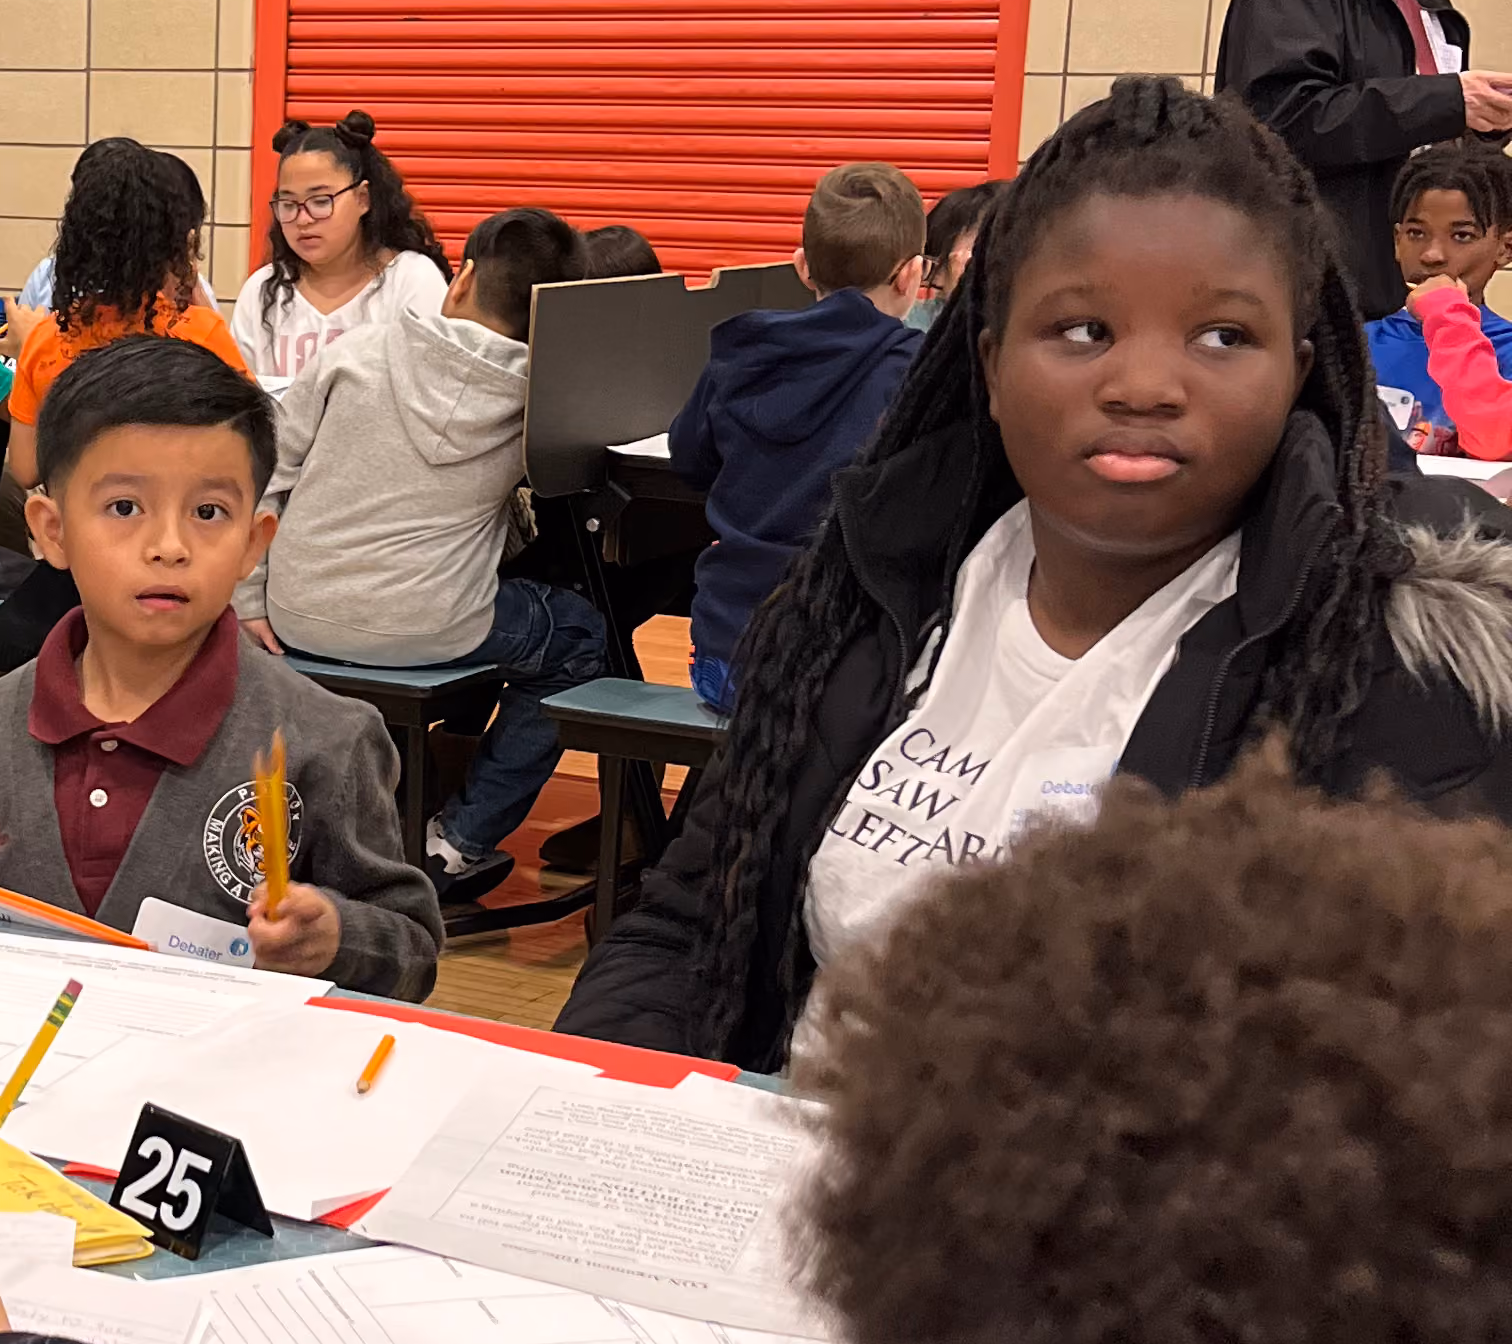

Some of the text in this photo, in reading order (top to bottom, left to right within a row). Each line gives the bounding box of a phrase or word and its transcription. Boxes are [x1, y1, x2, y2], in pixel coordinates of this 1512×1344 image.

[857, 759, 961, 822] SAW
[1040, 780, 1100, 796] Debate
[206, 817, 243, 898] MAKING A
[168, 935, 223, 961] Debater
[119, 1136, 212, 1231] 25
